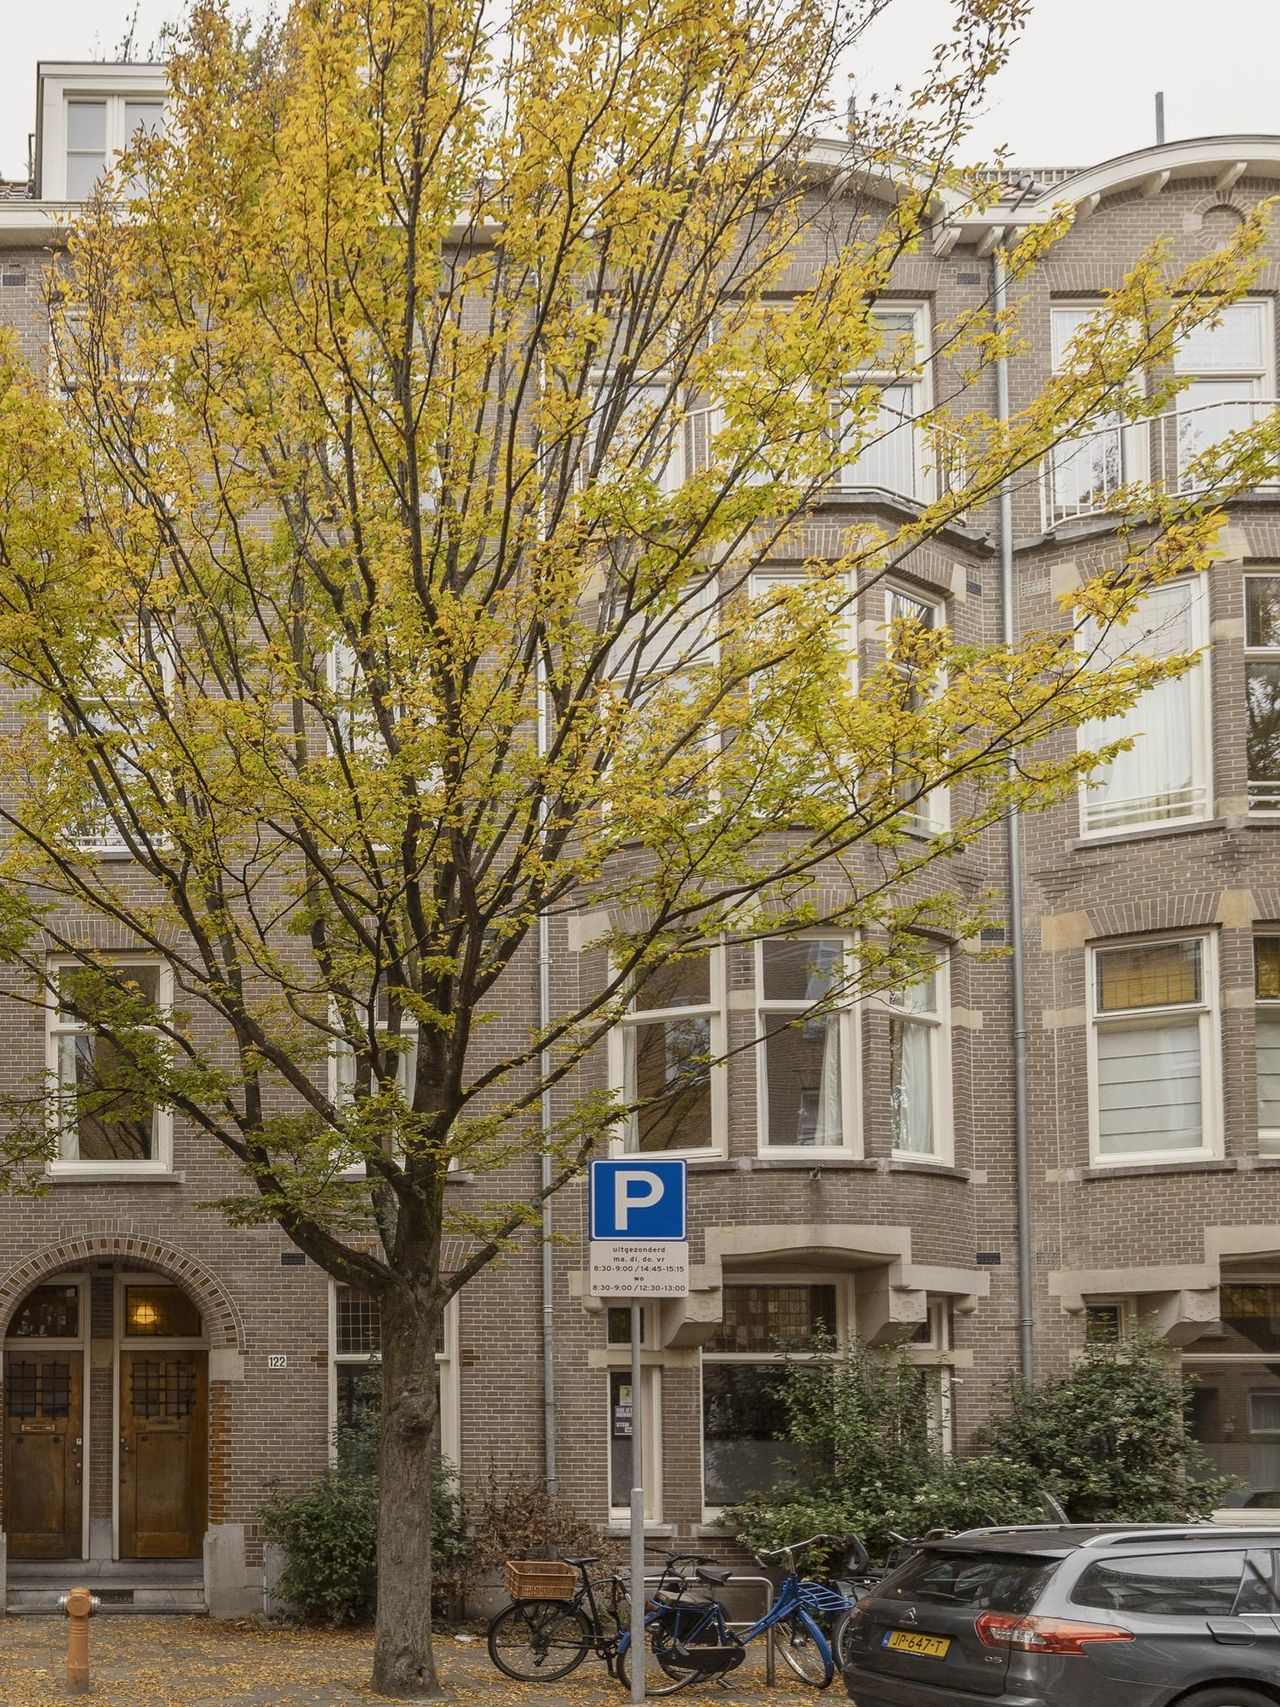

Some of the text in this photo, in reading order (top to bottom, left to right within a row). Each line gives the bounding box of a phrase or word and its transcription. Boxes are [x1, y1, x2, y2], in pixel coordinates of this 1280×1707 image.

[614, 1170, 665, 1231] P
[612, 1246, 666, 1254] uitgezonderd
[269, 1356, 286, 1367] 122
[892, 1634, 944, 1653] JP-647-T
